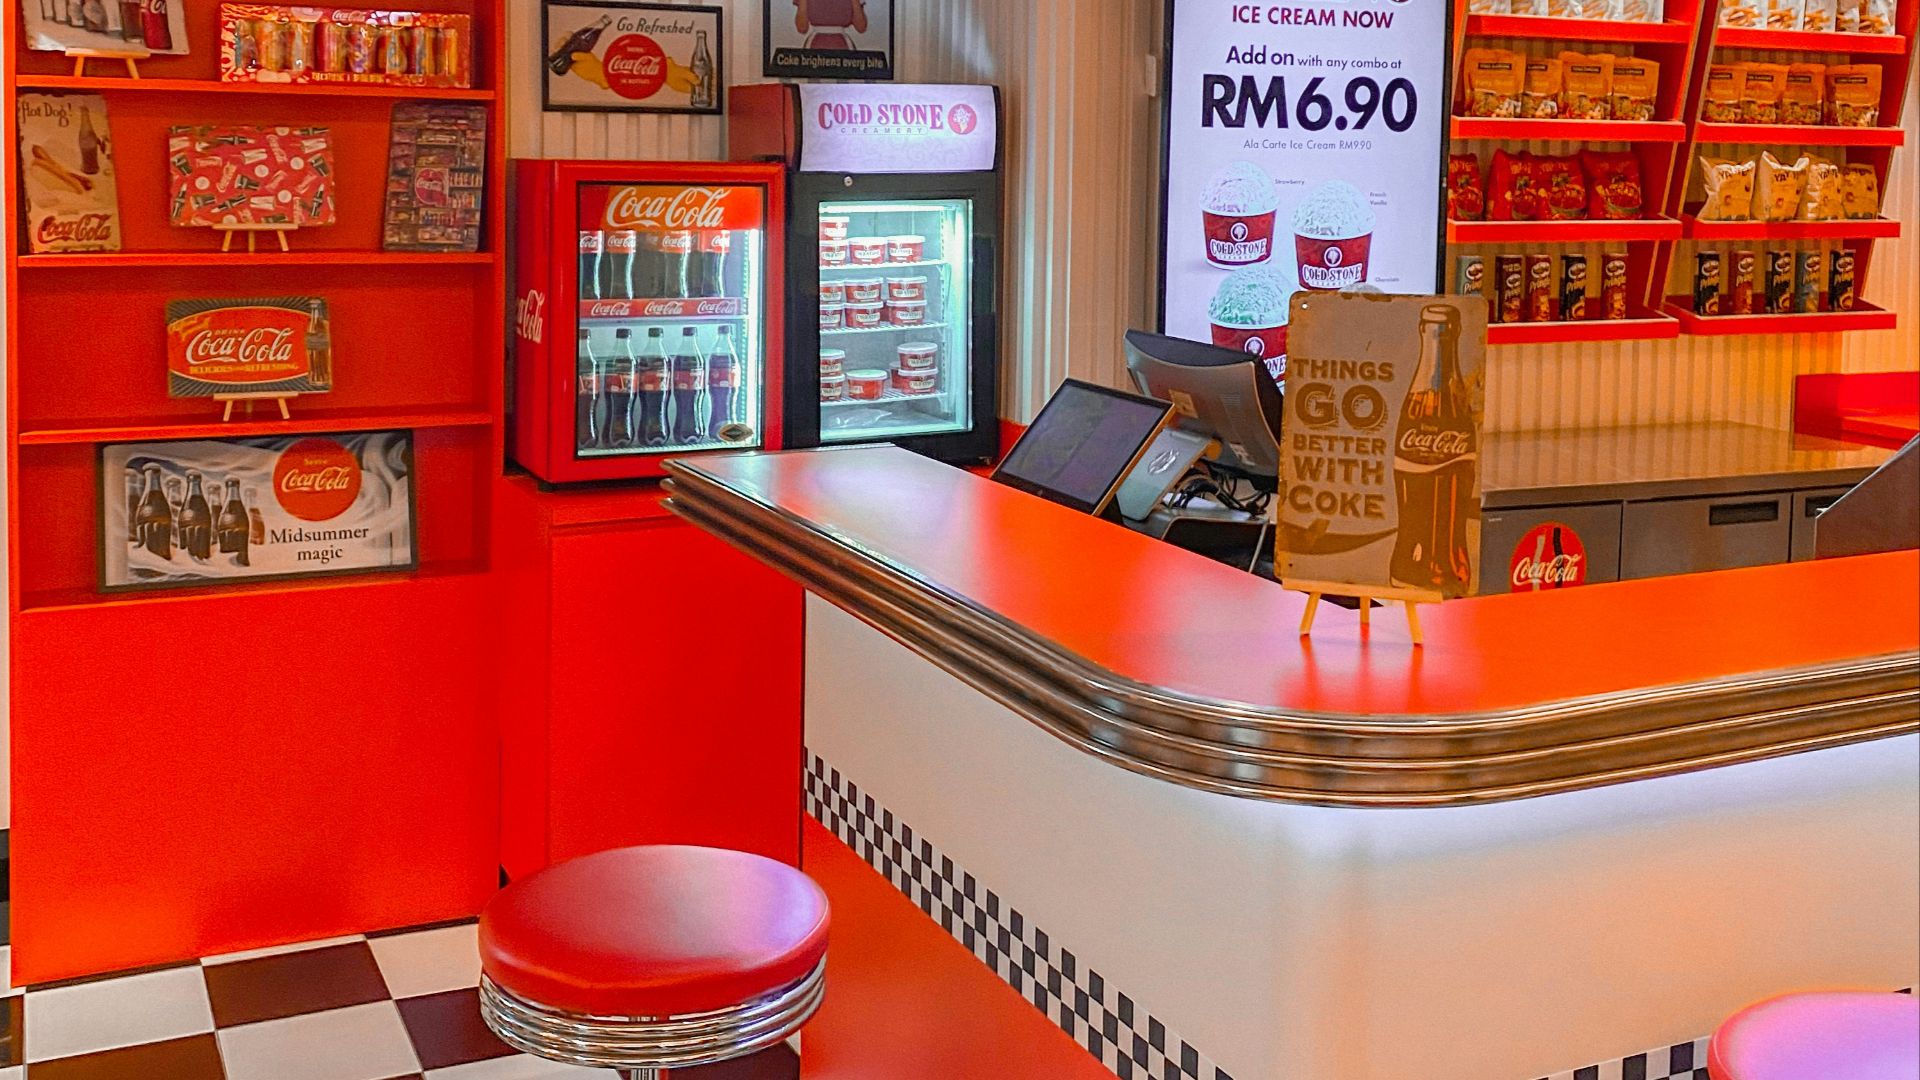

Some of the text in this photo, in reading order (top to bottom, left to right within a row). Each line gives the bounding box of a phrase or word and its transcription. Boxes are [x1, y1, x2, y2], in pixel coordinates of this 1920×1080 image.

[617, 17, 694, 35] Go Refreshed
[1232, 5, 1394, 29] ICE CREAM NOW
[608, 55, 662, 76] Coca-Cola
[777, 54, 884, 70] Coke brightens every bite
[1226, 44, 1402, 71] Add on with any combo at
[22, 101, 73, 128] Hot Dog!
[818, 102, 944, 130] COLD STONE
[1243, 138, 1259, 149] Ala
[1262, 139, 1287, 150] Carte
[1290, 140, 1303, 150] Ice
[1306, 140, 1336, 150] Cream
[606, 187, 732, 227] Coca-Cola
[37, 214, 113, 244] Coca-Cola
[1211, 240, 1267, 256] COLD STONE
[1303, 265, 1361, 281] COLD STONE
[591, 302, 630, 316] Coca-Cola
[644, 301, 684, 315] Coca-Cola
[697, 300, 737, 314] Coca-Cola
[186, 327, 294, 365] Coca-Cola
[1293, 358, 1394, 381] THINGS
[1295, 382, 1388, 431] GO
[1293, 433, 1387, 455] BETTER
[1400, 428, 1470, 454] Coca-Cola
[281, 466, 351, 492] Coca-Cola
[1294, 455, 1384, 485] WITH
[1289, 484, 1385, 520] COKE
[270, 528, 369, 544] Midsummer
[297, 545, 343, 564] magic
[1513, 554, 1581, 586] Coca-Cola
